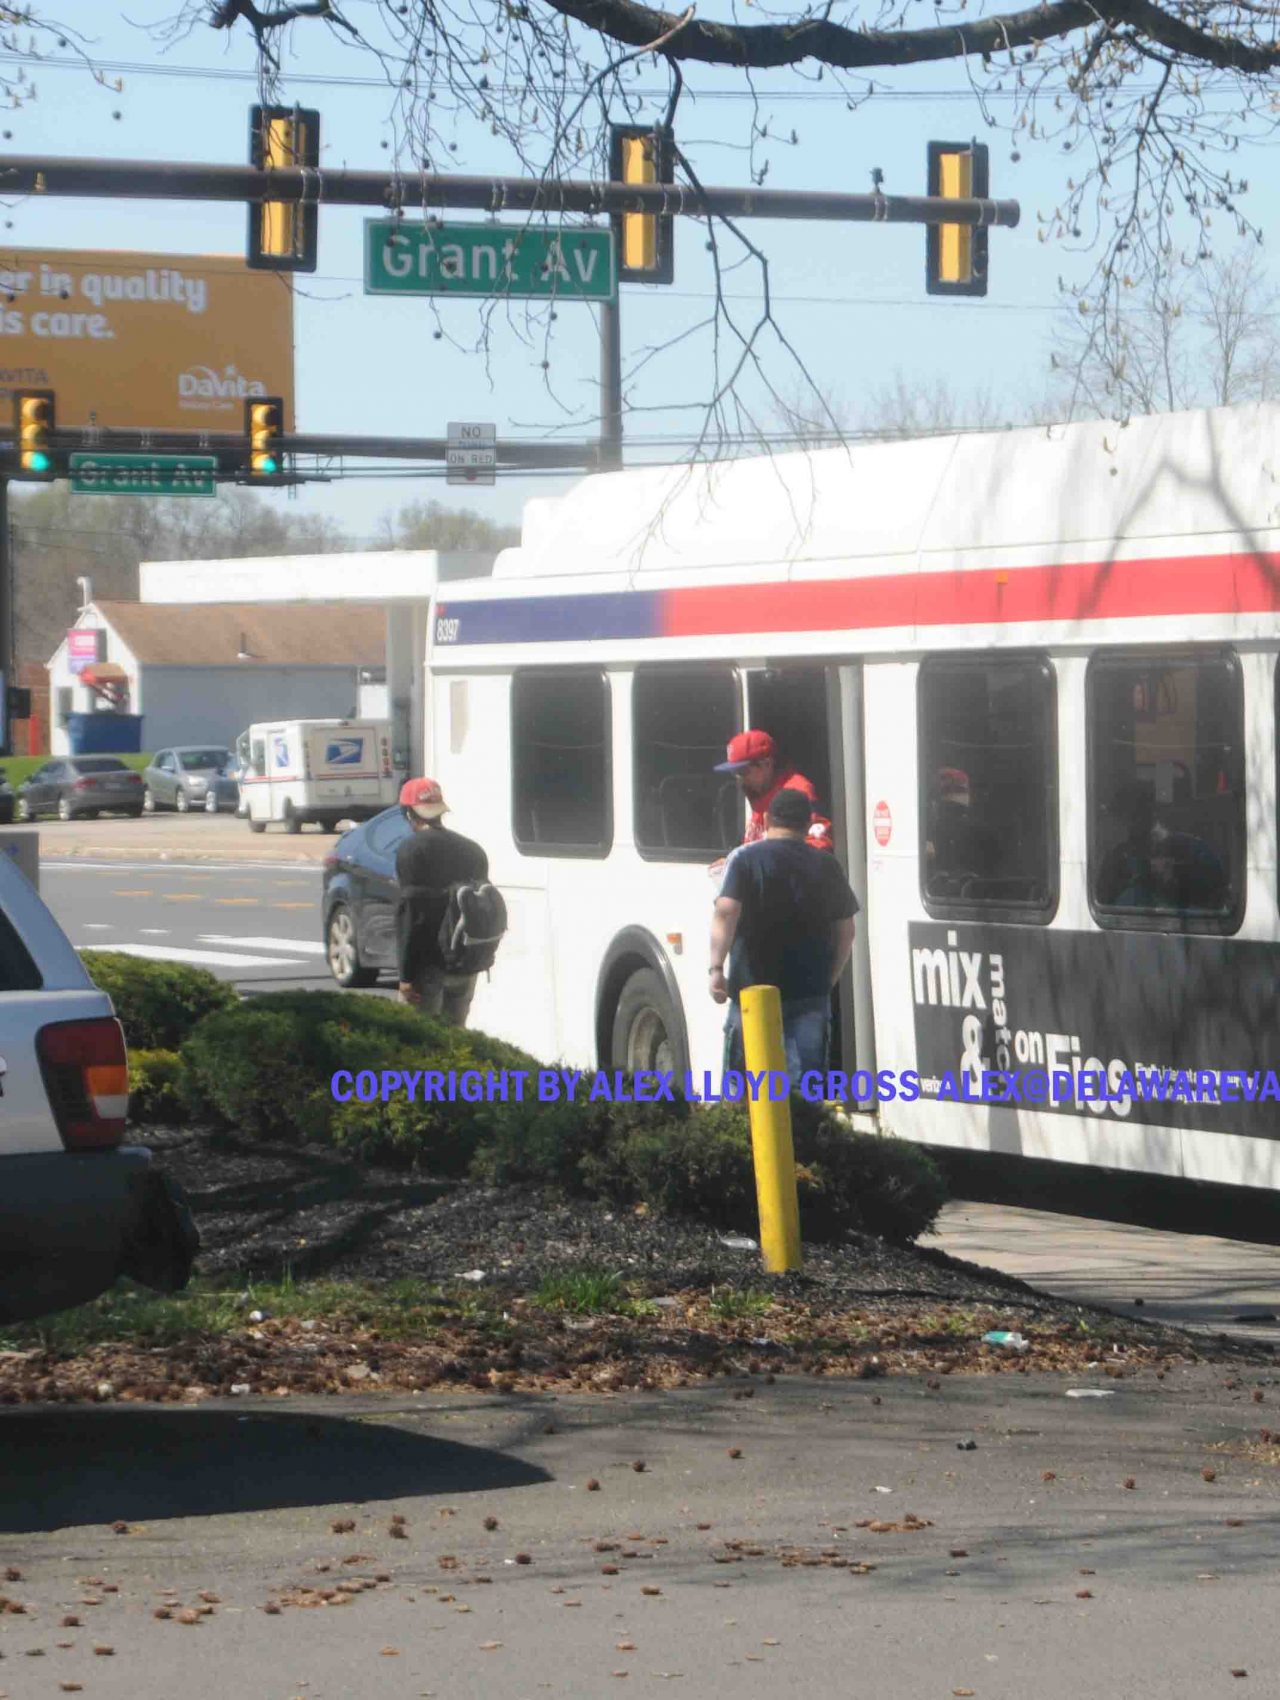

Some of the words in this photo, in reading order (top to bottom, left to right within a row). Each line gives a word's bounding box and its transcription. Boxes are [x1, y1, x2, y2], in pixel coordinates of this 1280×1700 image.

[382, 234, 519, 281] Grant
[540, 239, 598, 283] Av
[40, 262, 73, 296] in
[80, 270, 207, 315] quality
[30, 311, 116, 338] care.
[461, 426, 481, 439] NO
[79, 460, 161, 486] Grant
[436, 618, 460, 641] 8397
[912, 929, 987, 1009] mix
[1014, 1029, 1045, 1064] on
[919, 1074, 958, 1095] veriz
